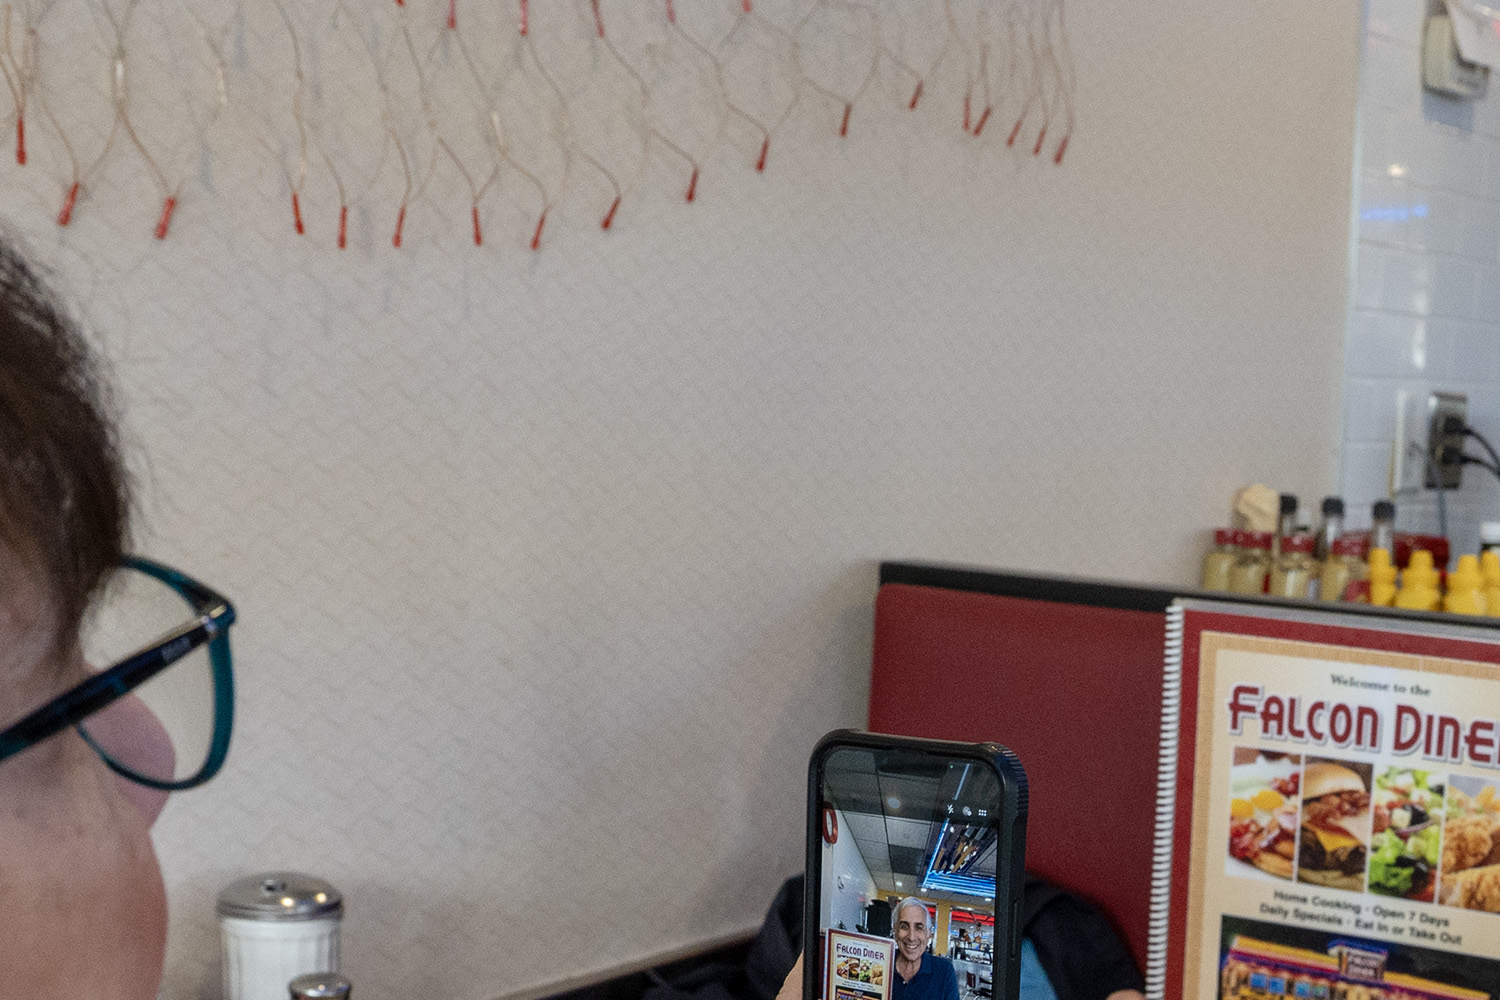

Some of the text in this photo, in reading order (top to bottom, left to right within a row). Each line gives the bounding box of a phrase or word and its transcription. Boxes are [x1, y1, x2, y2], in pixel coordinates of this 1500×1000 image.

[1330, 673, 1432, 698] Welcome to the
[1228, 685, 1384, 752] FALCON
[1273, 890, 1451, 929] Home Cooking Open 7 Days
